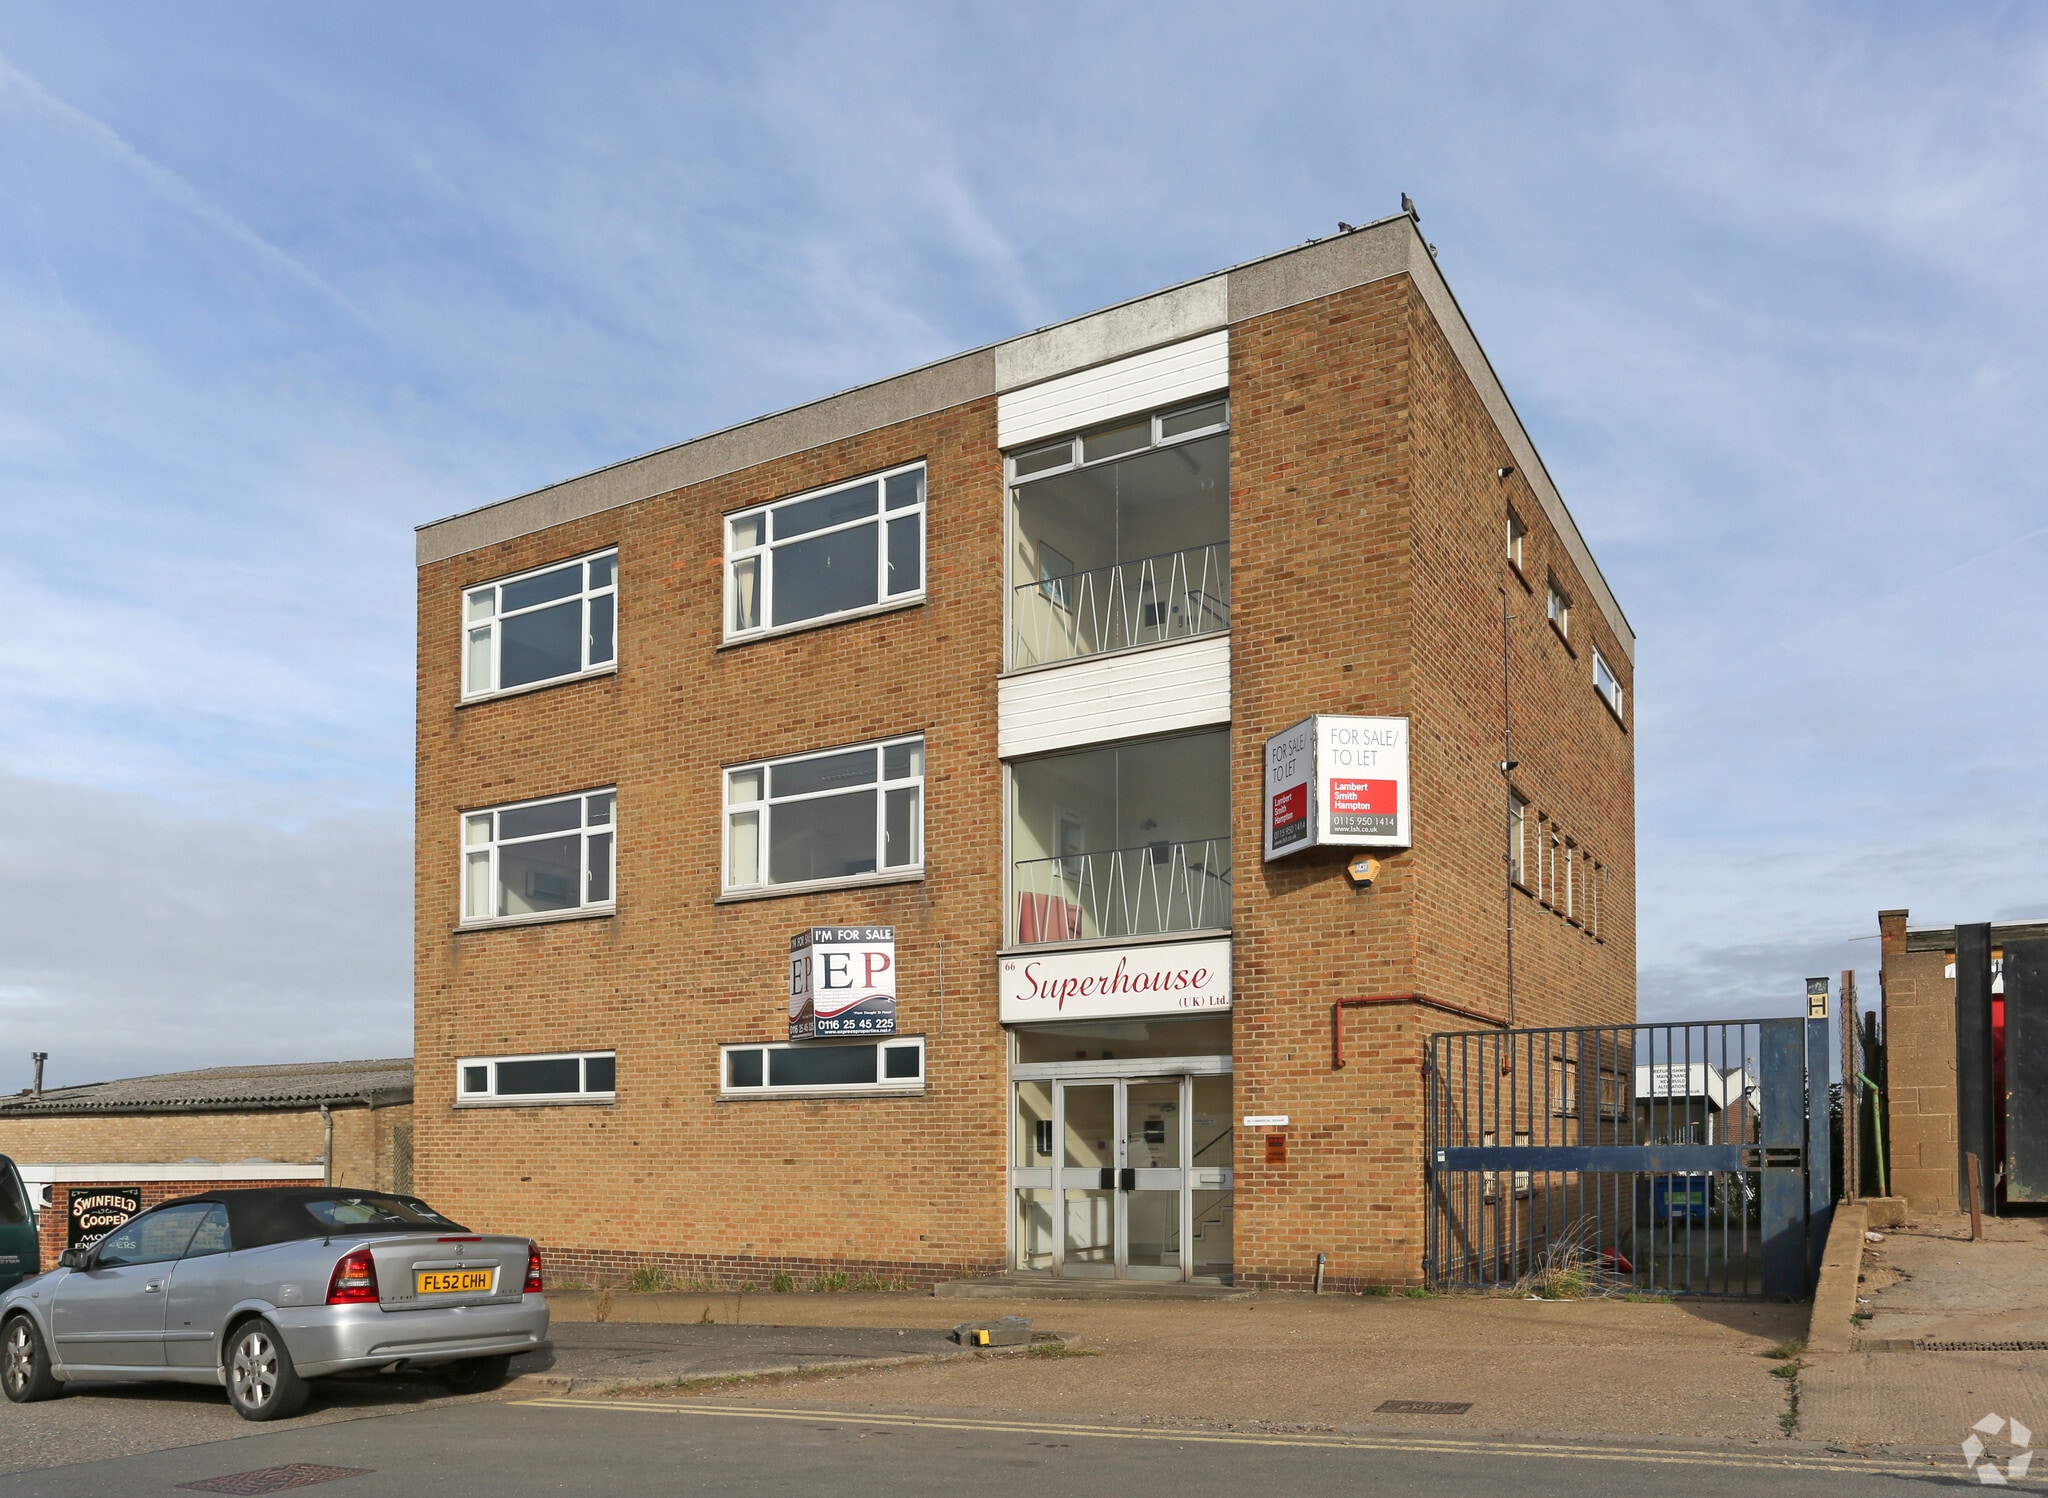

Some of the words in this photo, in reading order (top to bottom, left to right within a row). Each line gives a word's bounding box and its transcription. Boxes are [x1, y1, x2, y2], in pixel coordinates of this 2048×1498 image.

[1331, 728, 1359, 745] FOR
[1363, 730, 1399, 748] SALE/
[1273, 743, 1288, 764] FOR
[1331, 749, 1352, 766] TO
[1357, 750, 1378, 766] LET
[1272, 765, 1284, 783] TO
[1285, 758, 1297, 779] LET
[1334, 782, 1369, 791] Lambert
[1274, 793, 1292, 807] Lambert
[1334, 791, 1358, 801] Smith
[1274, 804, 1287, 816] Smith
[1334, 801, 1371, 812] Hampton
[1274, 812, 1293, 825] Hampton
[1333, 816, 1355, 826] 0115
[1356, 816, 1373, 826] 950
[1375, 817, 1395, 826] 1414
[1333, 825, 1378, 833] www.lsh.co.uk
[815, 930, 832, 942] I'M
[838, 930, 860, 941] FOR
[866, 929, 891, 940] SALE
[1005, 962, 1016, 972] 66
[1016, 956, 1214, 1011] Superhouse
[1179, 996, 1205, 1007] (UK)
[1209, 995, 1229, 1006] Ltd.
[818, 1020, 839, 1030] 0116
[843, 1020, 856, 1029] 25
[859, 1019, 872, 1029] 45
[875, 1018, 894, 1028] 225
[72, 1195, 137, 1216] SWINFIELD
[424, 1275, 459, 1291] FL52
[462, 1273, 486, 1289] CHH
